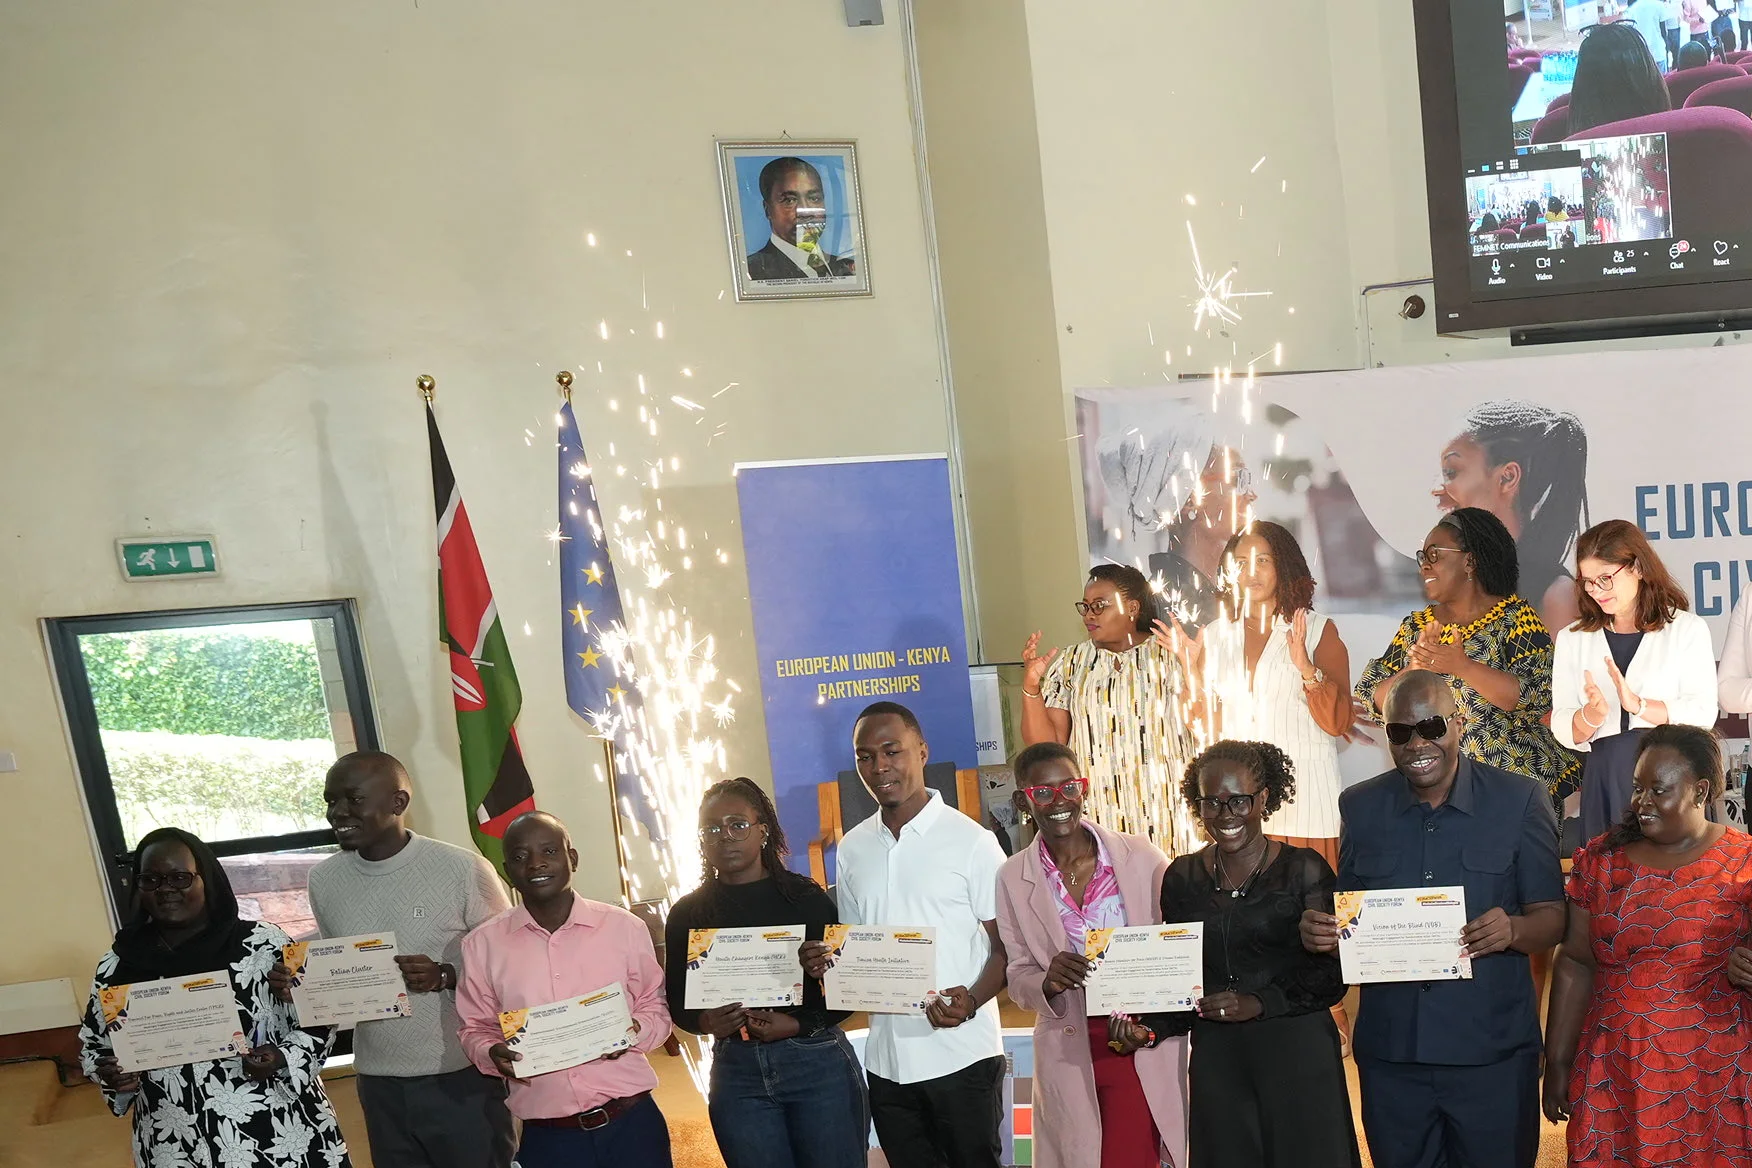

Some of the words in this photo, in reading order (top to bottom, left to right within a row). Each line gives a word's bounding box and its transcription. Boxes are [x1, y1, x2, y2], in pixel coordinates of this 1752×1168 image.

[1500, 239, 1550, 250] Communications
[1713, 258, 1730, 266] React
[1603, 266, 1636, 276] Participants
[1488, 277, 1506, 285] Audio
[776, 654, 849, 677] EUROPEAN
[853, 651, 895, 670] UNION
[907, 646, 950, 665] KENYA
[818, 674, 921, 700] PARTNERSHIPS
[352, 965, 373, 973] Cluster
